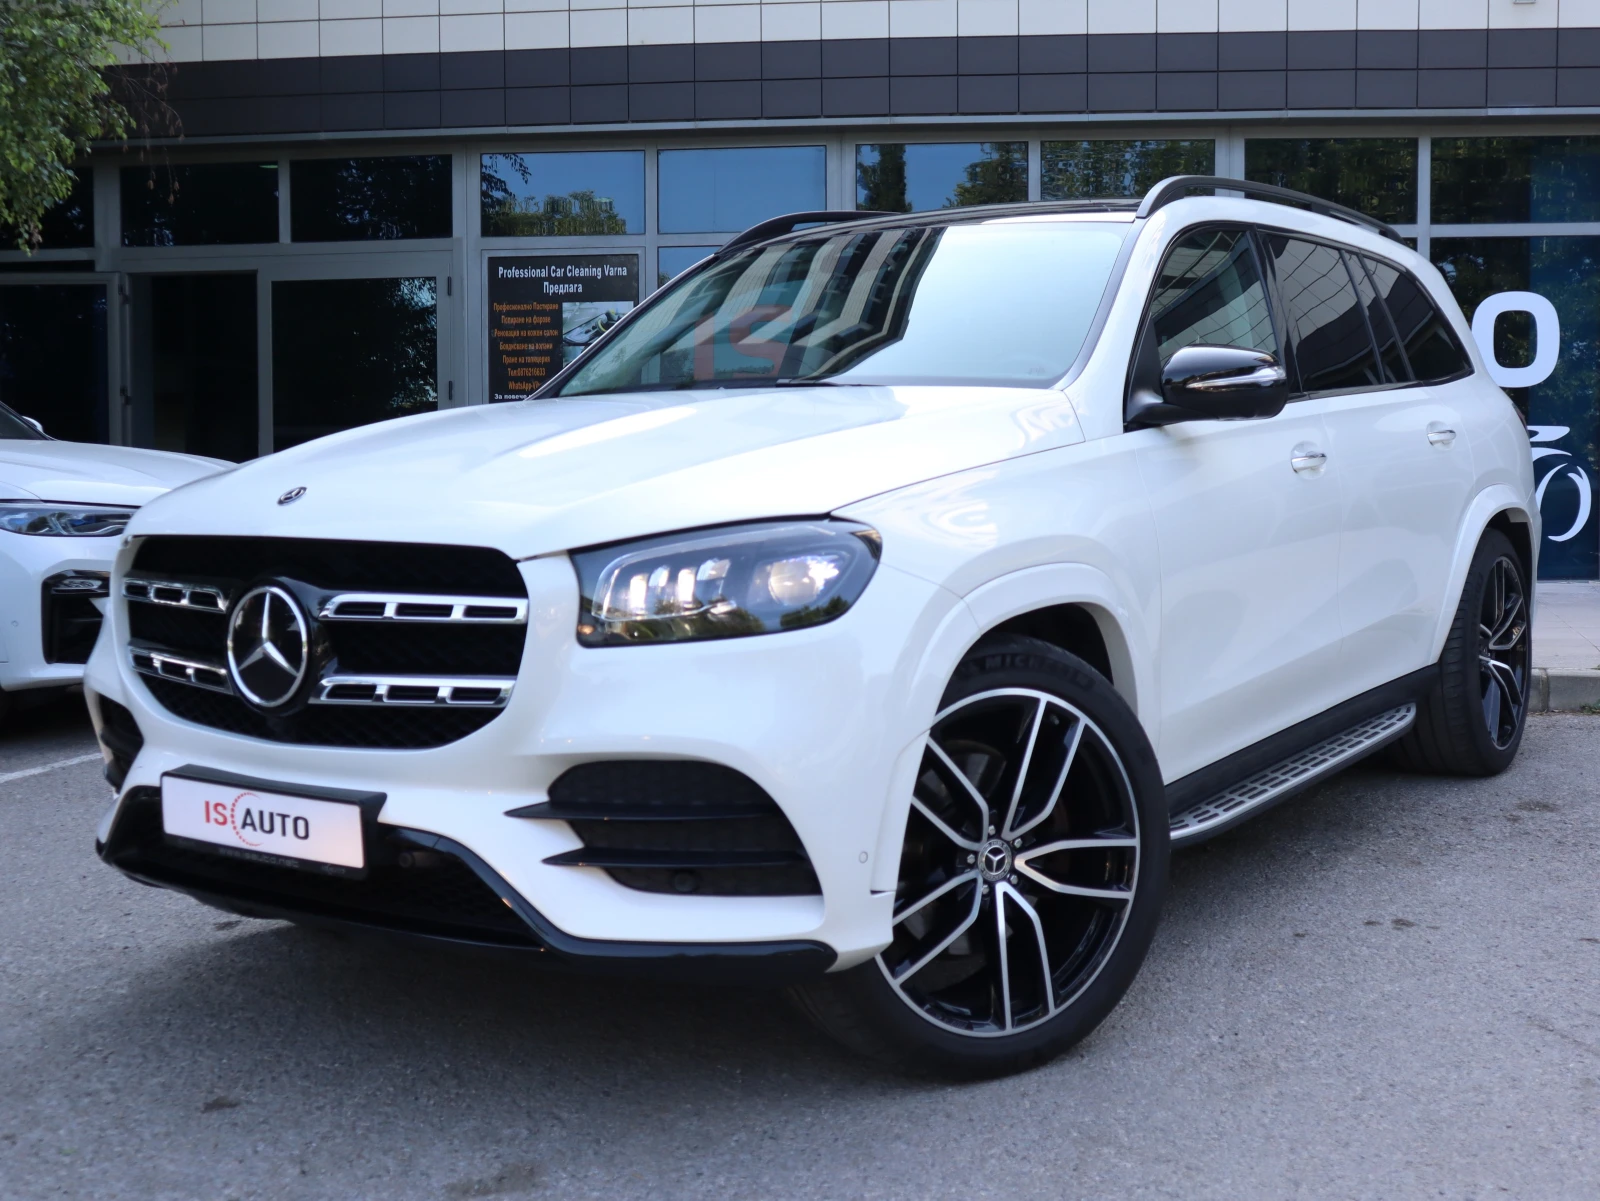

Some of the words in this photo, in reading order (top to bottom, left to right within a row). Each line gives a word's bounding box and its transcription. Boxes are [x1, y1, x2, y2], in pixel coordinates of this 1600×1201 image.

[498, 266, 549, 278] Professional
[550, 266, 564, 277] Car
[566, 265, 602, 279] Cleaning
[603, 264, 628, 276] Varna
[543, 281, 583, 295] Предлага
[493, 302, 532, 312] Професионално
[204, 800, 228, 826] IS
[240, 808, 310, 841] AUTO
